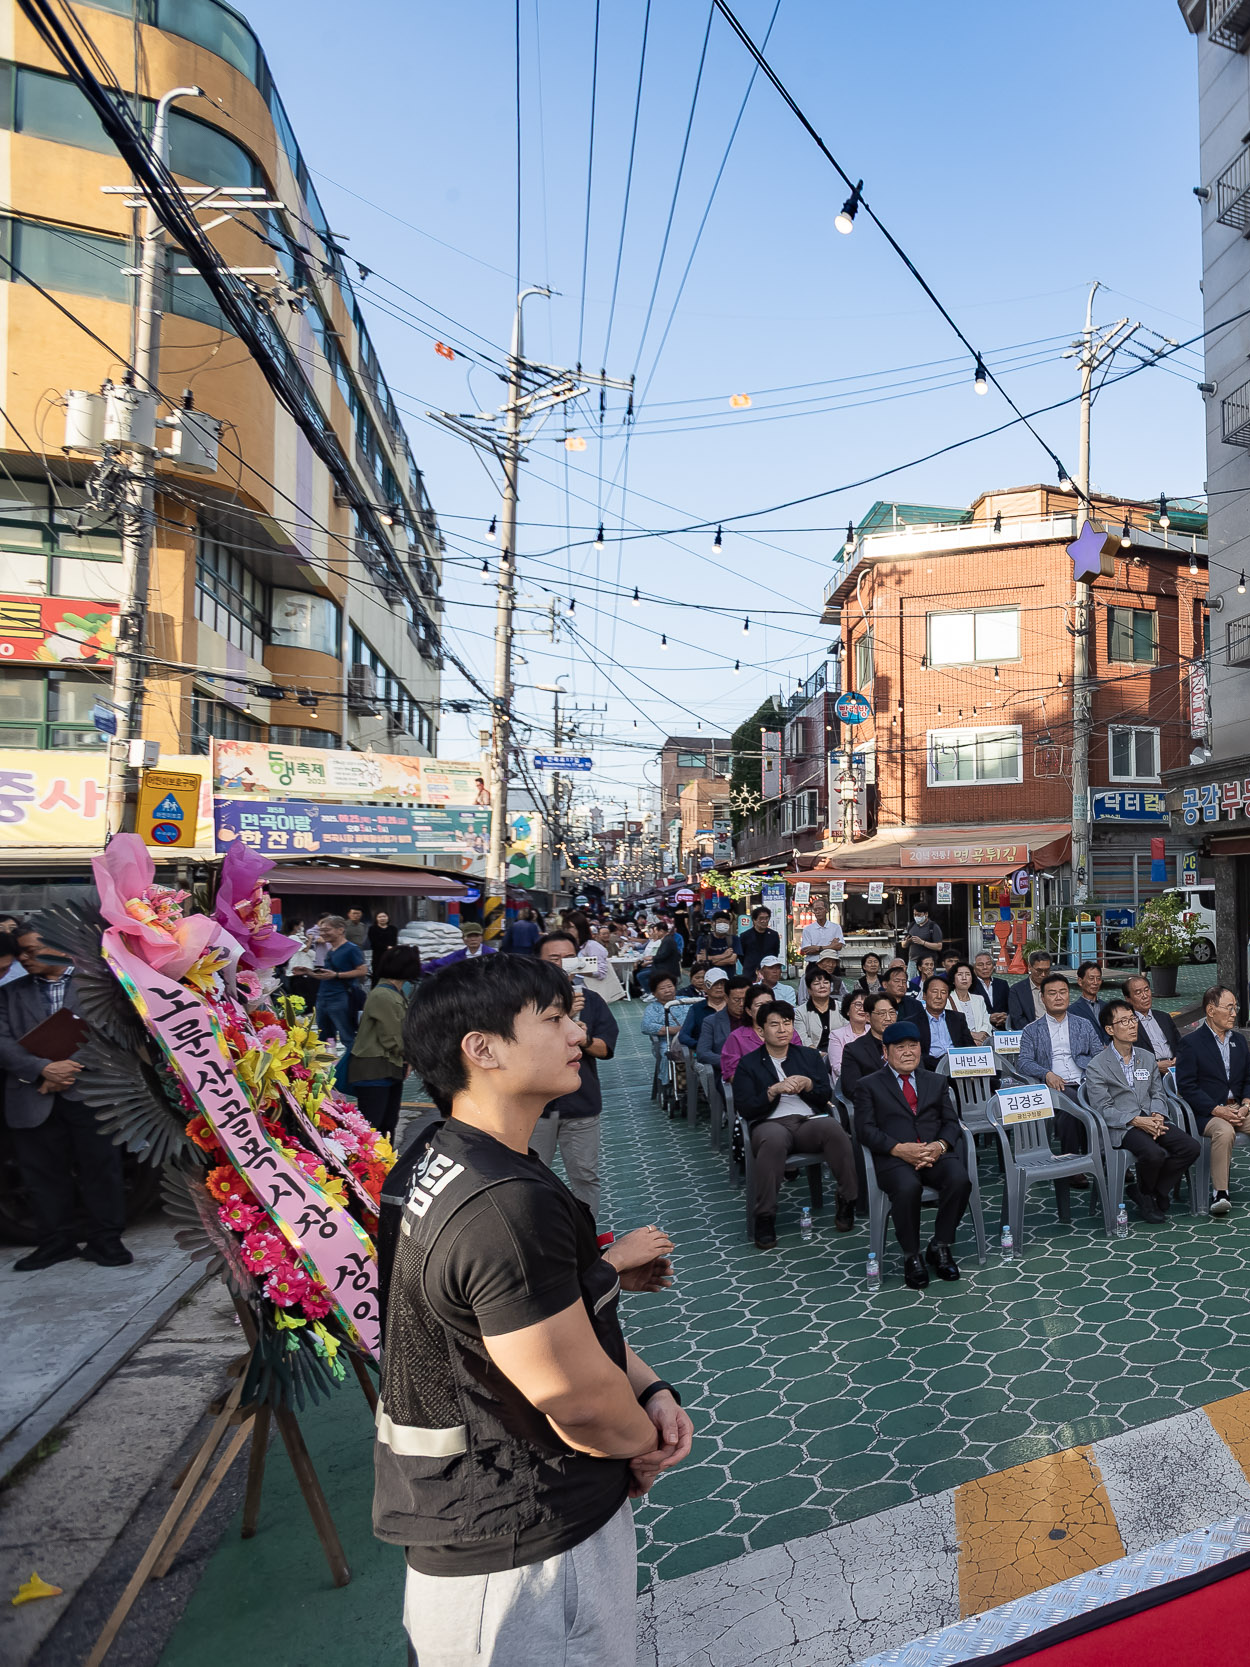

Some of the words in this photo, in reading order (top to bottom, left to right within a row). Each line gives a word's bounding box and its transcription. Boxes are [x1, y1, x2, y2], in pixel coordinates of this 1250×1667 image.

[839, 703, 868, 718] 빨래방
[240, 813, 312, 832] 면곡이랑
[239, 830, 263, 849] 한
[267, 831, 290, 850] 잔
[292, 830, 318, 850] 해
[909, 850, 930, 861] 20년
[953, 846, 1017, 864] 면곡튀김
[1183, 855, 1196, 869] PC
[1000, 1036, 1019, 1046] 내빈
[955, 1055, 988, 1068] 내빈석
[1007, 1093, 1045, 1111] 김경호
[1017, 1110, 1042, 1120] 광진구청장
